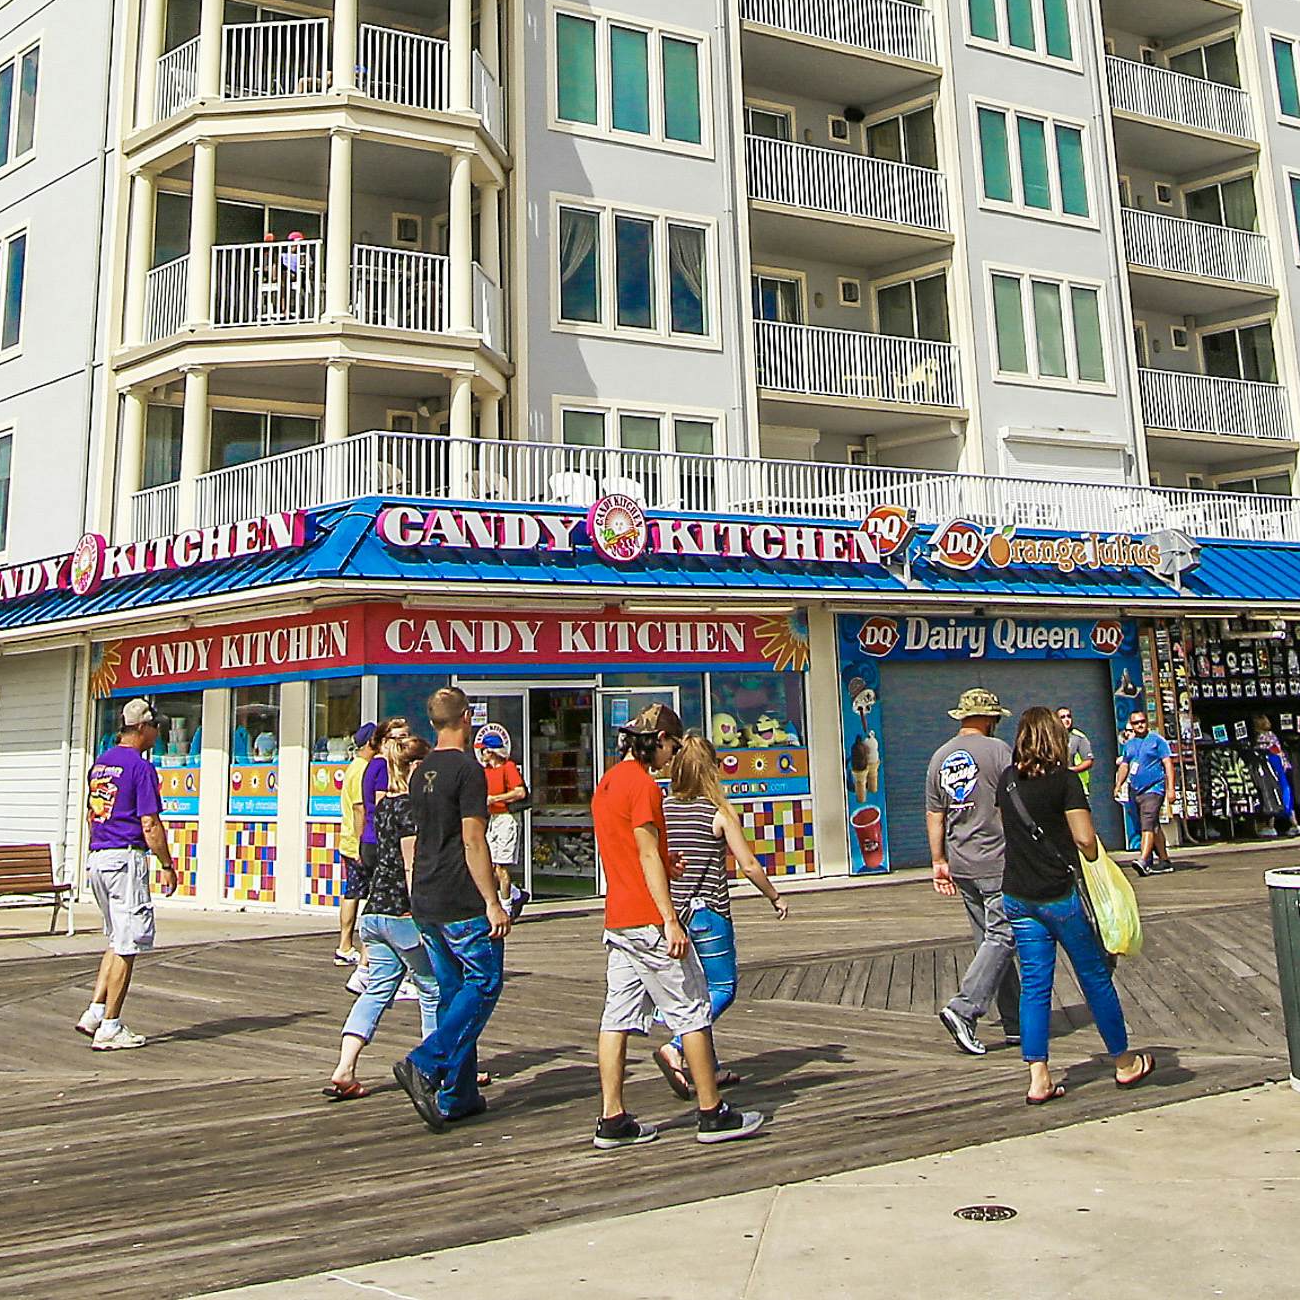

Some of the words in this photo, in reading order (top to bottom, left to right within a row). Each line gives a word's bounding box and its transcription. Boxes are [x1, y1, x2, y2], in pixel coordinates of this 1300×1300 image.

[101, 509, 303, 580] KITCHEN
[378, 506, 578, 552] CANDY
[658, 520, 882, 565] KITCHEN
[867, 514, 901, 544] DQ
[947, 530, 979, 558] DQ
[1087, 532, 1162, 569] Julius
[130, 638, 213, 679] CANDY
[220, 620, 349, 670] KITCHEN
[385, 618, 545, 654] CANDY
[557, 619, 746, 654] KITCHEN
[865, 625, 893, 649] DQ
[904, 617, 986, 657] Dairy
[993, 617, 1080, 654] Queen
[1095, 626, 1119, 648] DQ
